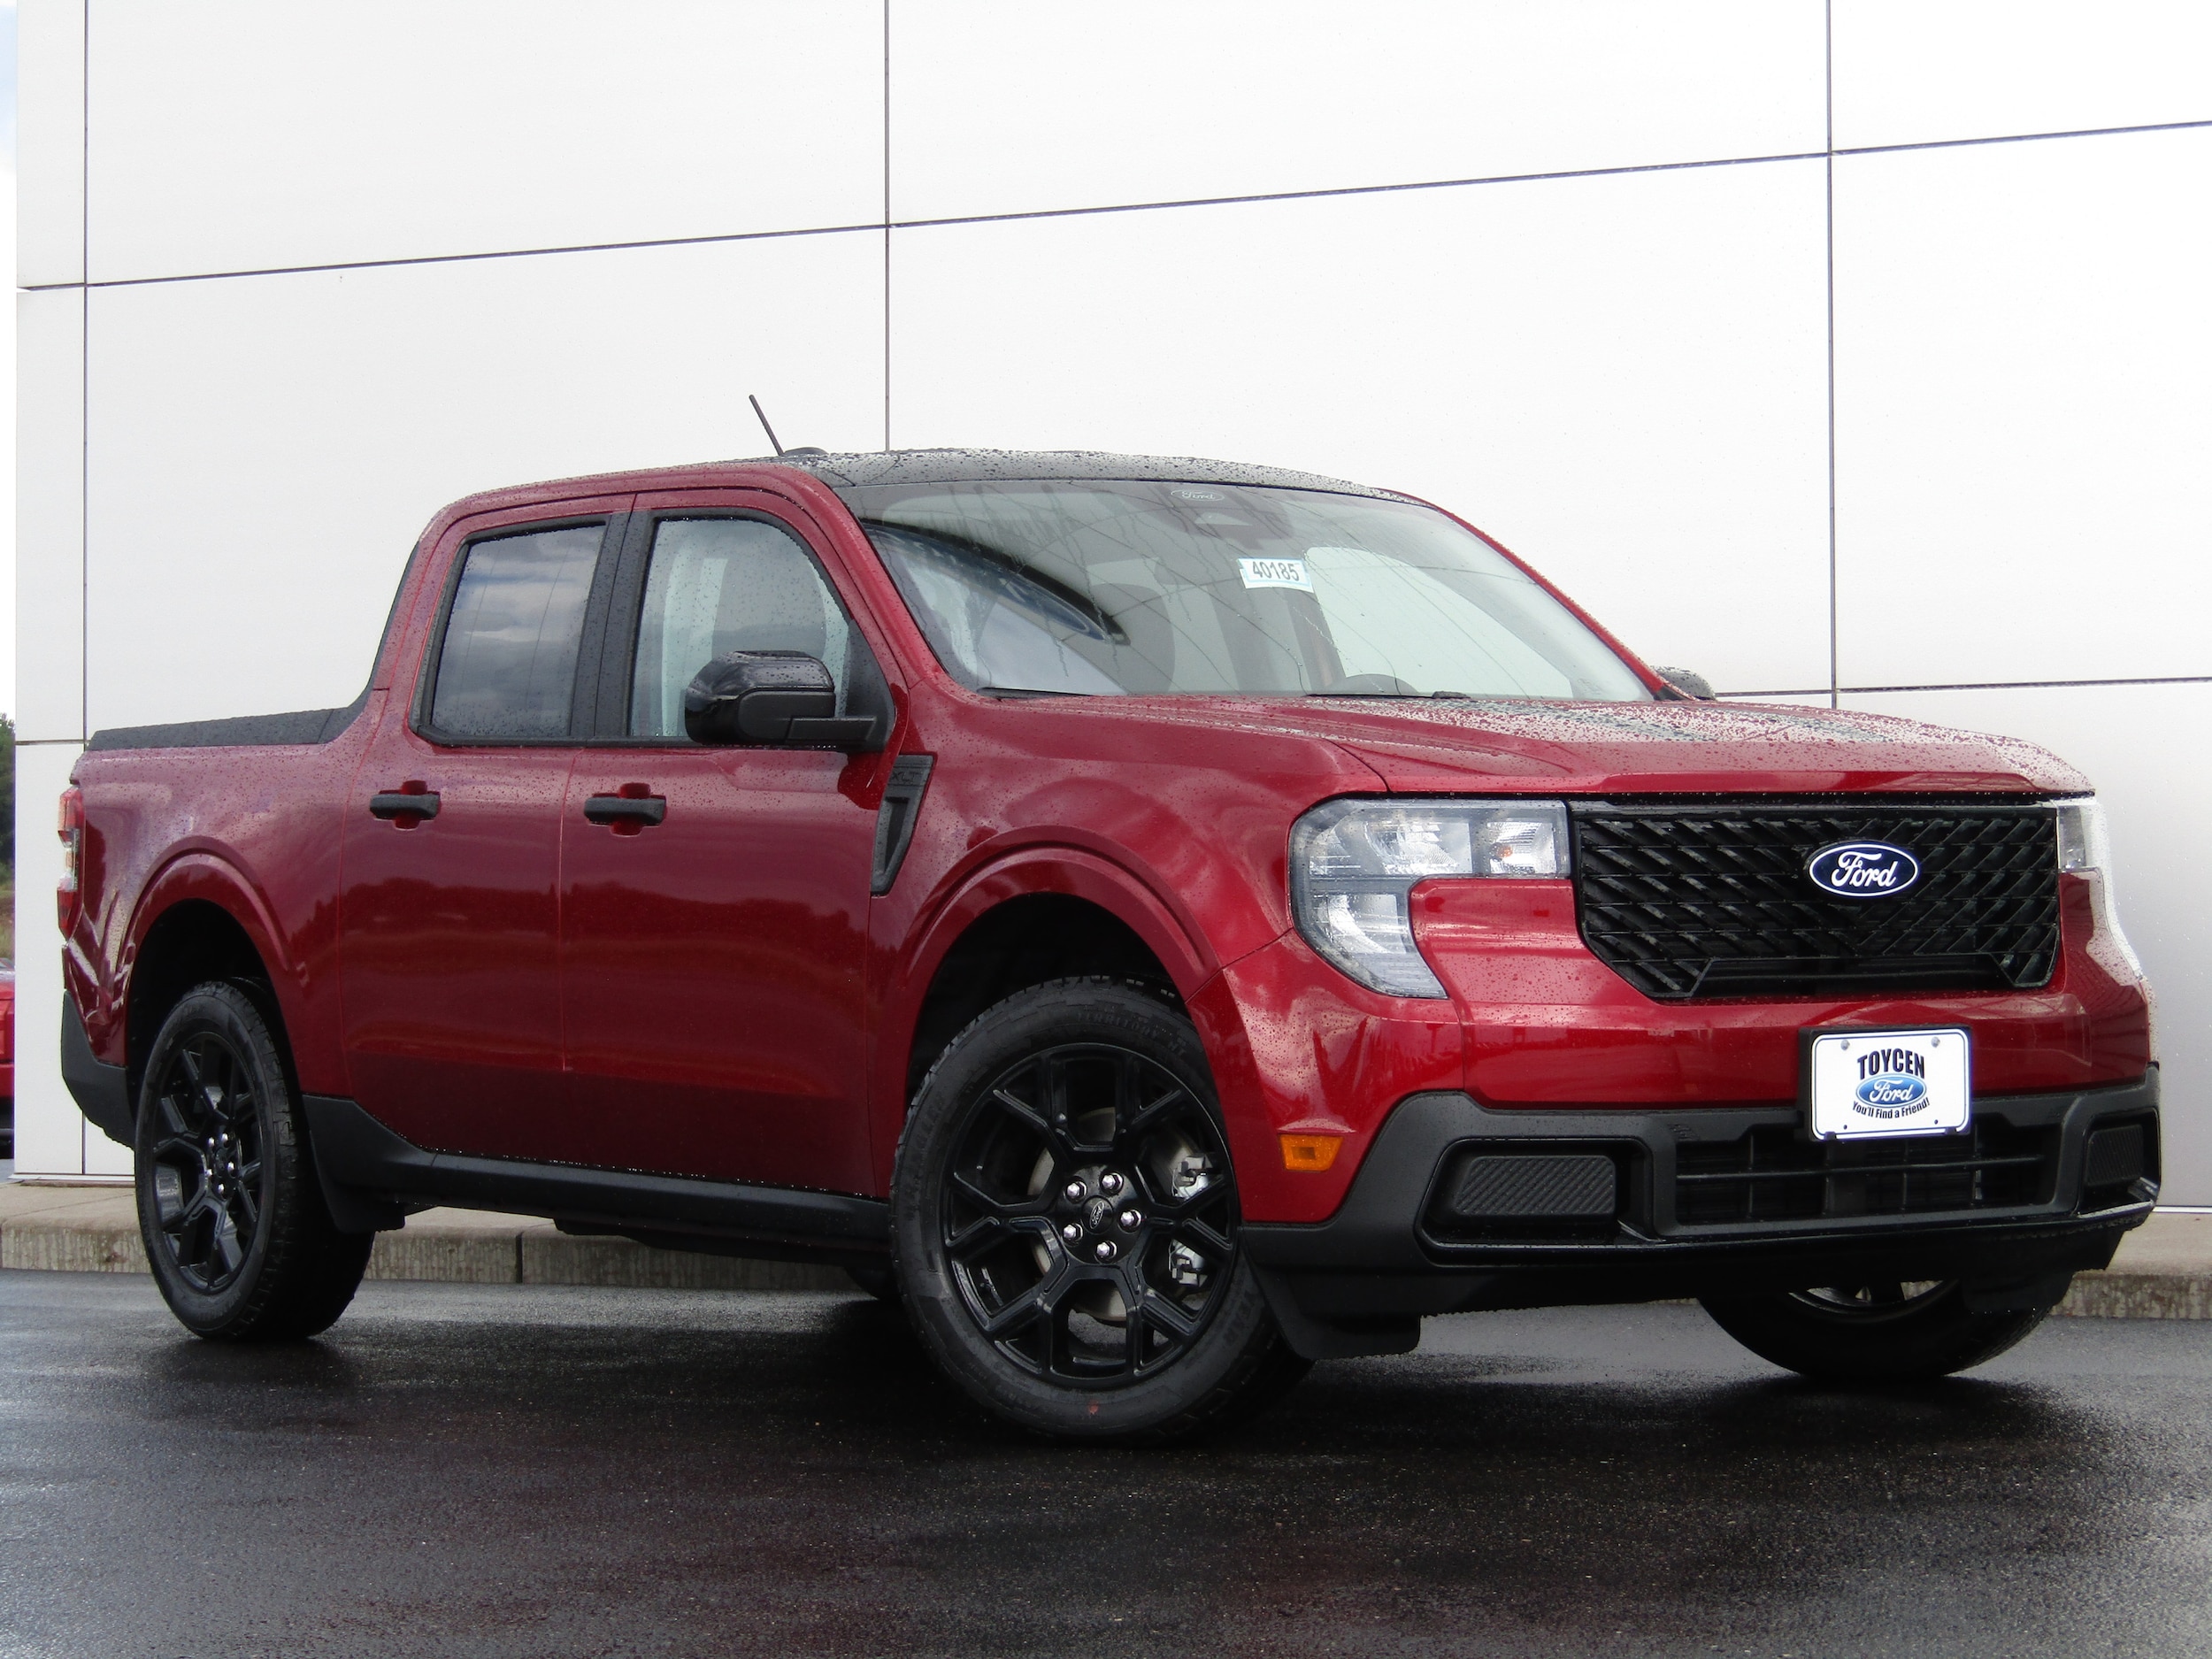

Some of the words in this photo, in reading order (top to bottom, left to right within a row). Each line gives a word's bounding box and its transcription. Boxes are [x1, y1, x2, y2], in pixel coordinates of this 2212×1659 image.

[1252, 561, 1300, 582] 40185
[891, 771, 922, 782] XLT
[1831, 850, 1899, 887] Ford
[1857, 1048, 1924, 1079] TOYCEN
[1869, 1079, 1913, 1102] Ford
[1852, 1100, 1875, 1118] You'll
[1876, 1108, 1893, 1119] Find
[1894, 1110, 1901, 1118] a
[1901, 1096, 1931, 1117] Friend!
